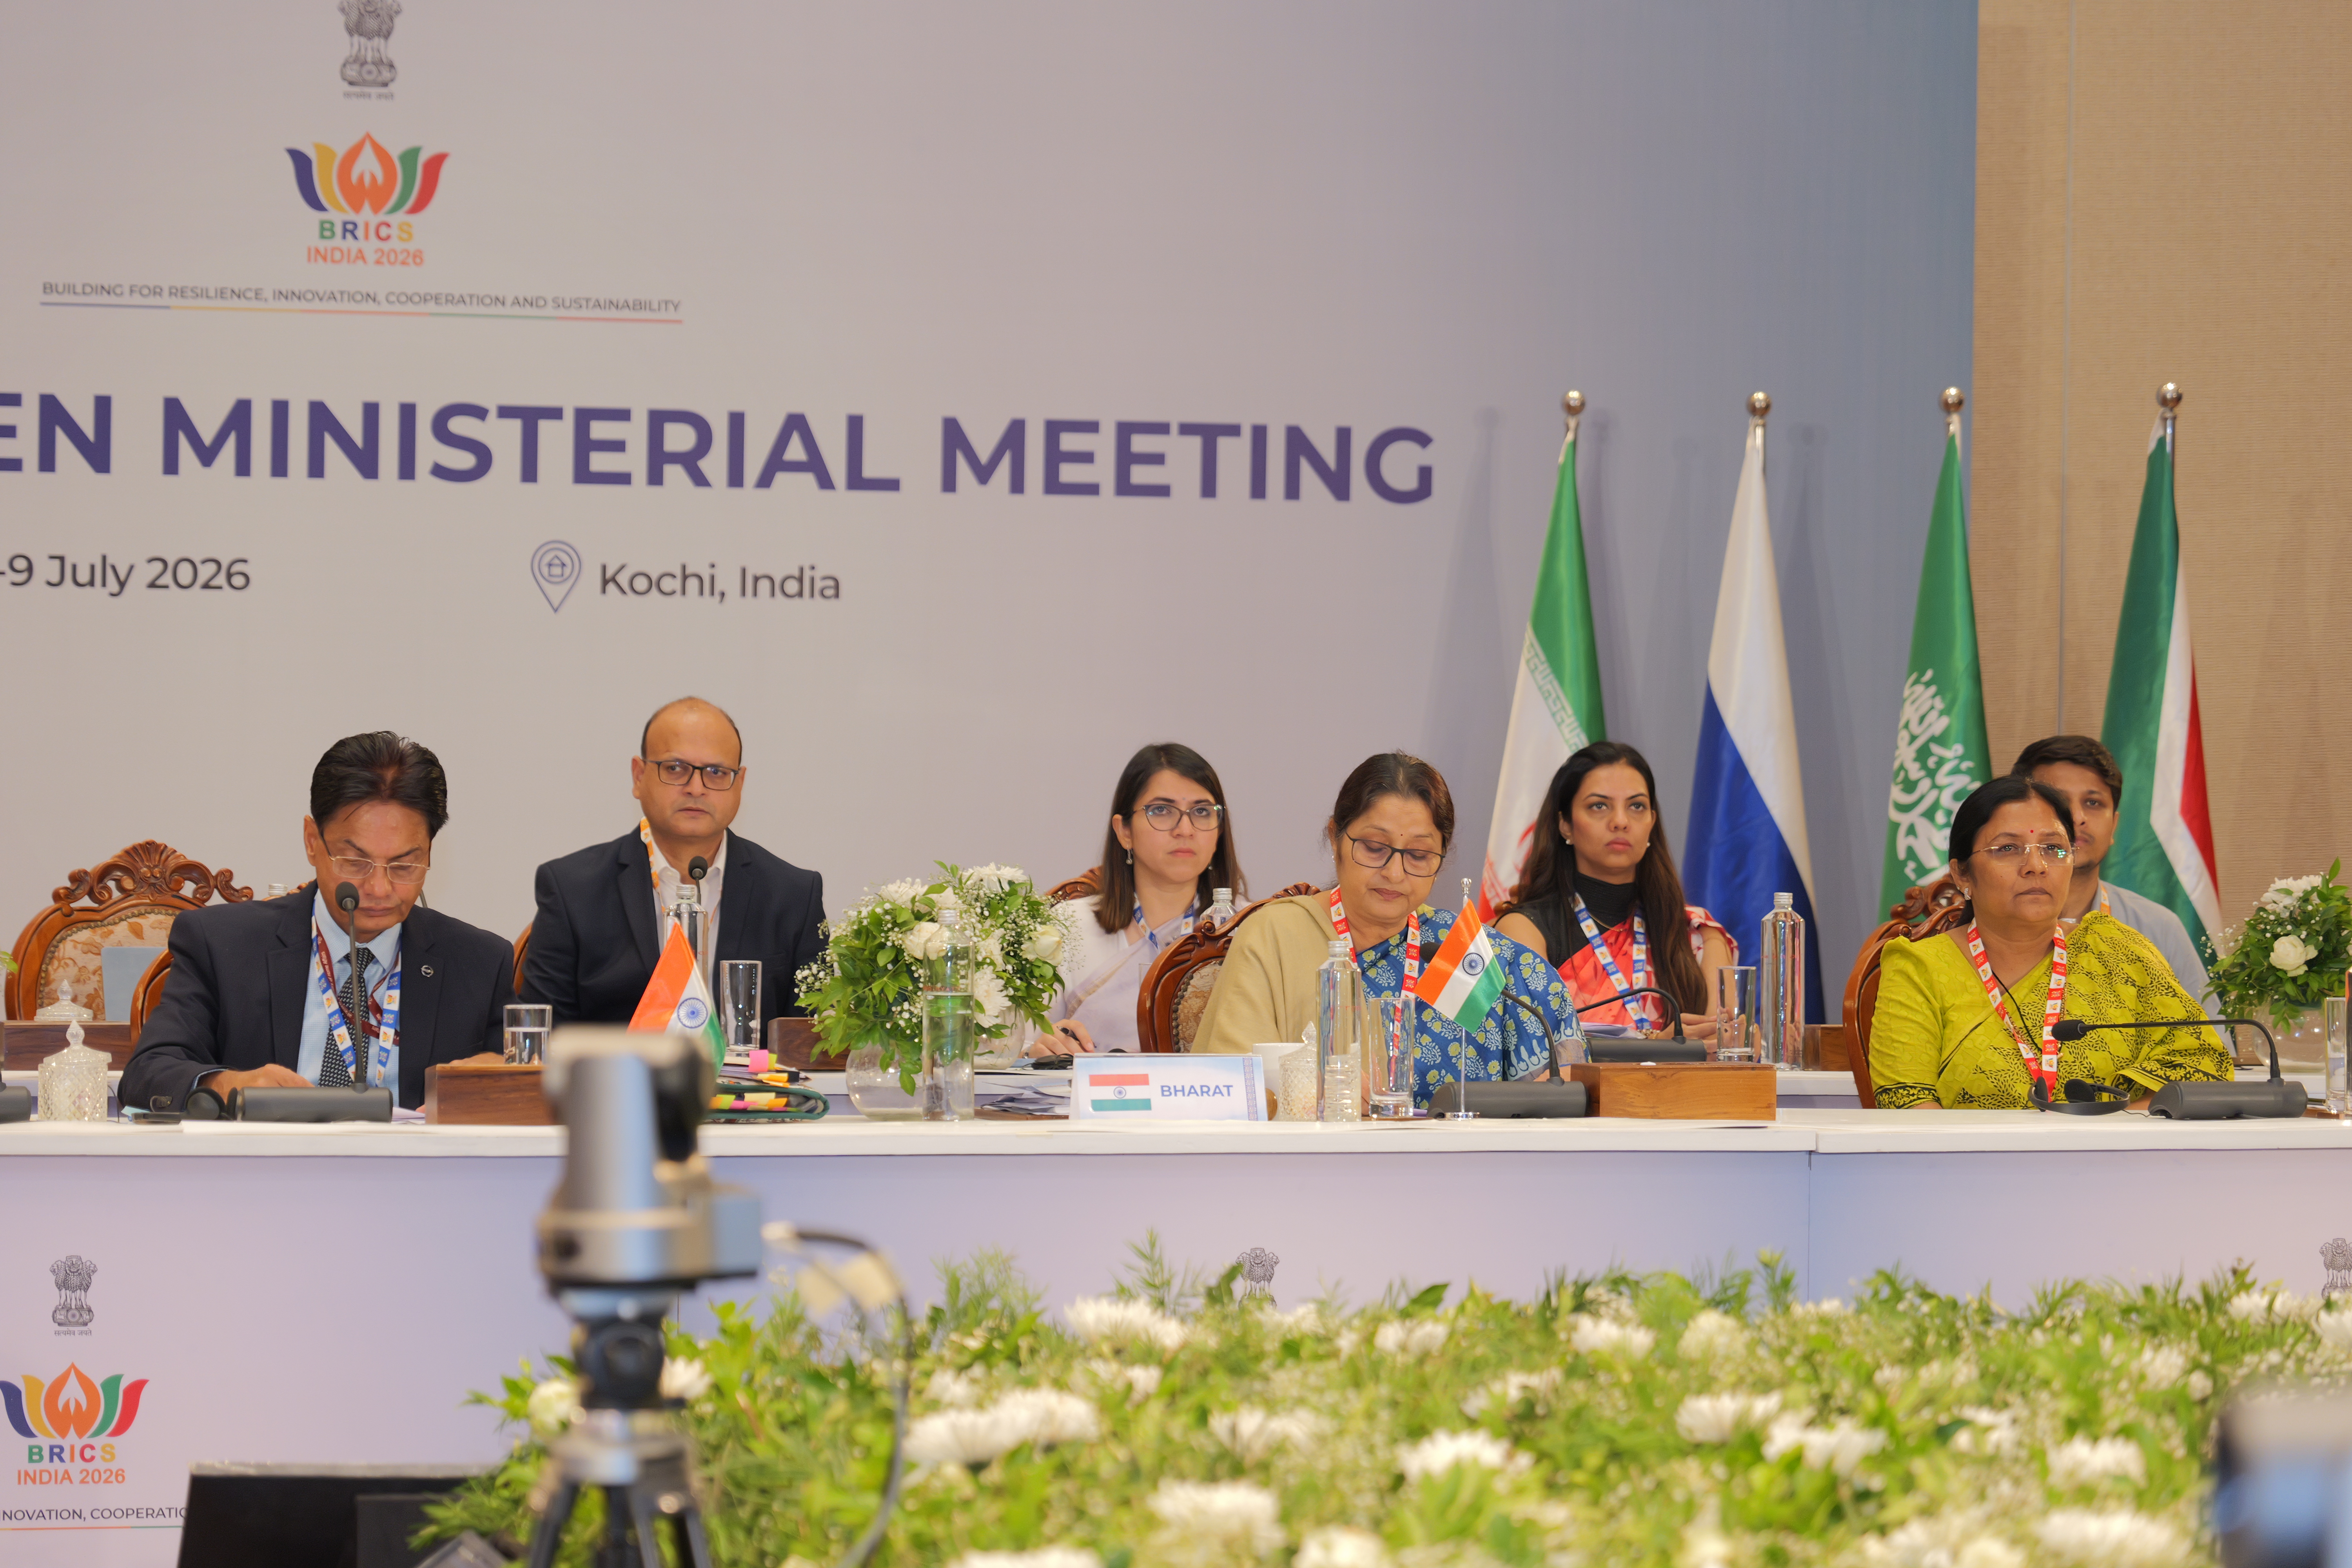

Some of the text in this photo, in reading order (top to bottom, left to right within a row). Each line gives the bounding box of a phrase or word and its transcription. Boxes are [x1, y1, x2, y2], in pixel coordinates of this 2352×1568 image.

[319, 220, 413, 241] BRICS
[307, 247, 424, 266] INDIA 2026
[43, 282, 681, 312] BUILDING FOR RESILIENCE, INNOVATION, COOPERATION AND SUSTAINABILITY
[163, 397, 900, 492] MINISTERIAL
[942, 417, 1434, 504] MEETING
[45, 554, 134, 597] July
[146, 557, 250, 590] 2026
[601, 563, 840, 603] Kochi, India
[1160, 1085, 1233, 1097] BHARAT
[77, 1328, 91, 1336] जयते
[28, 1443, 116, 1463] BRICS
[18, 1468, 125, 1485] INDIA 2026
[0, 1507, 187, 1521] NOVATION, COOPERATIO
